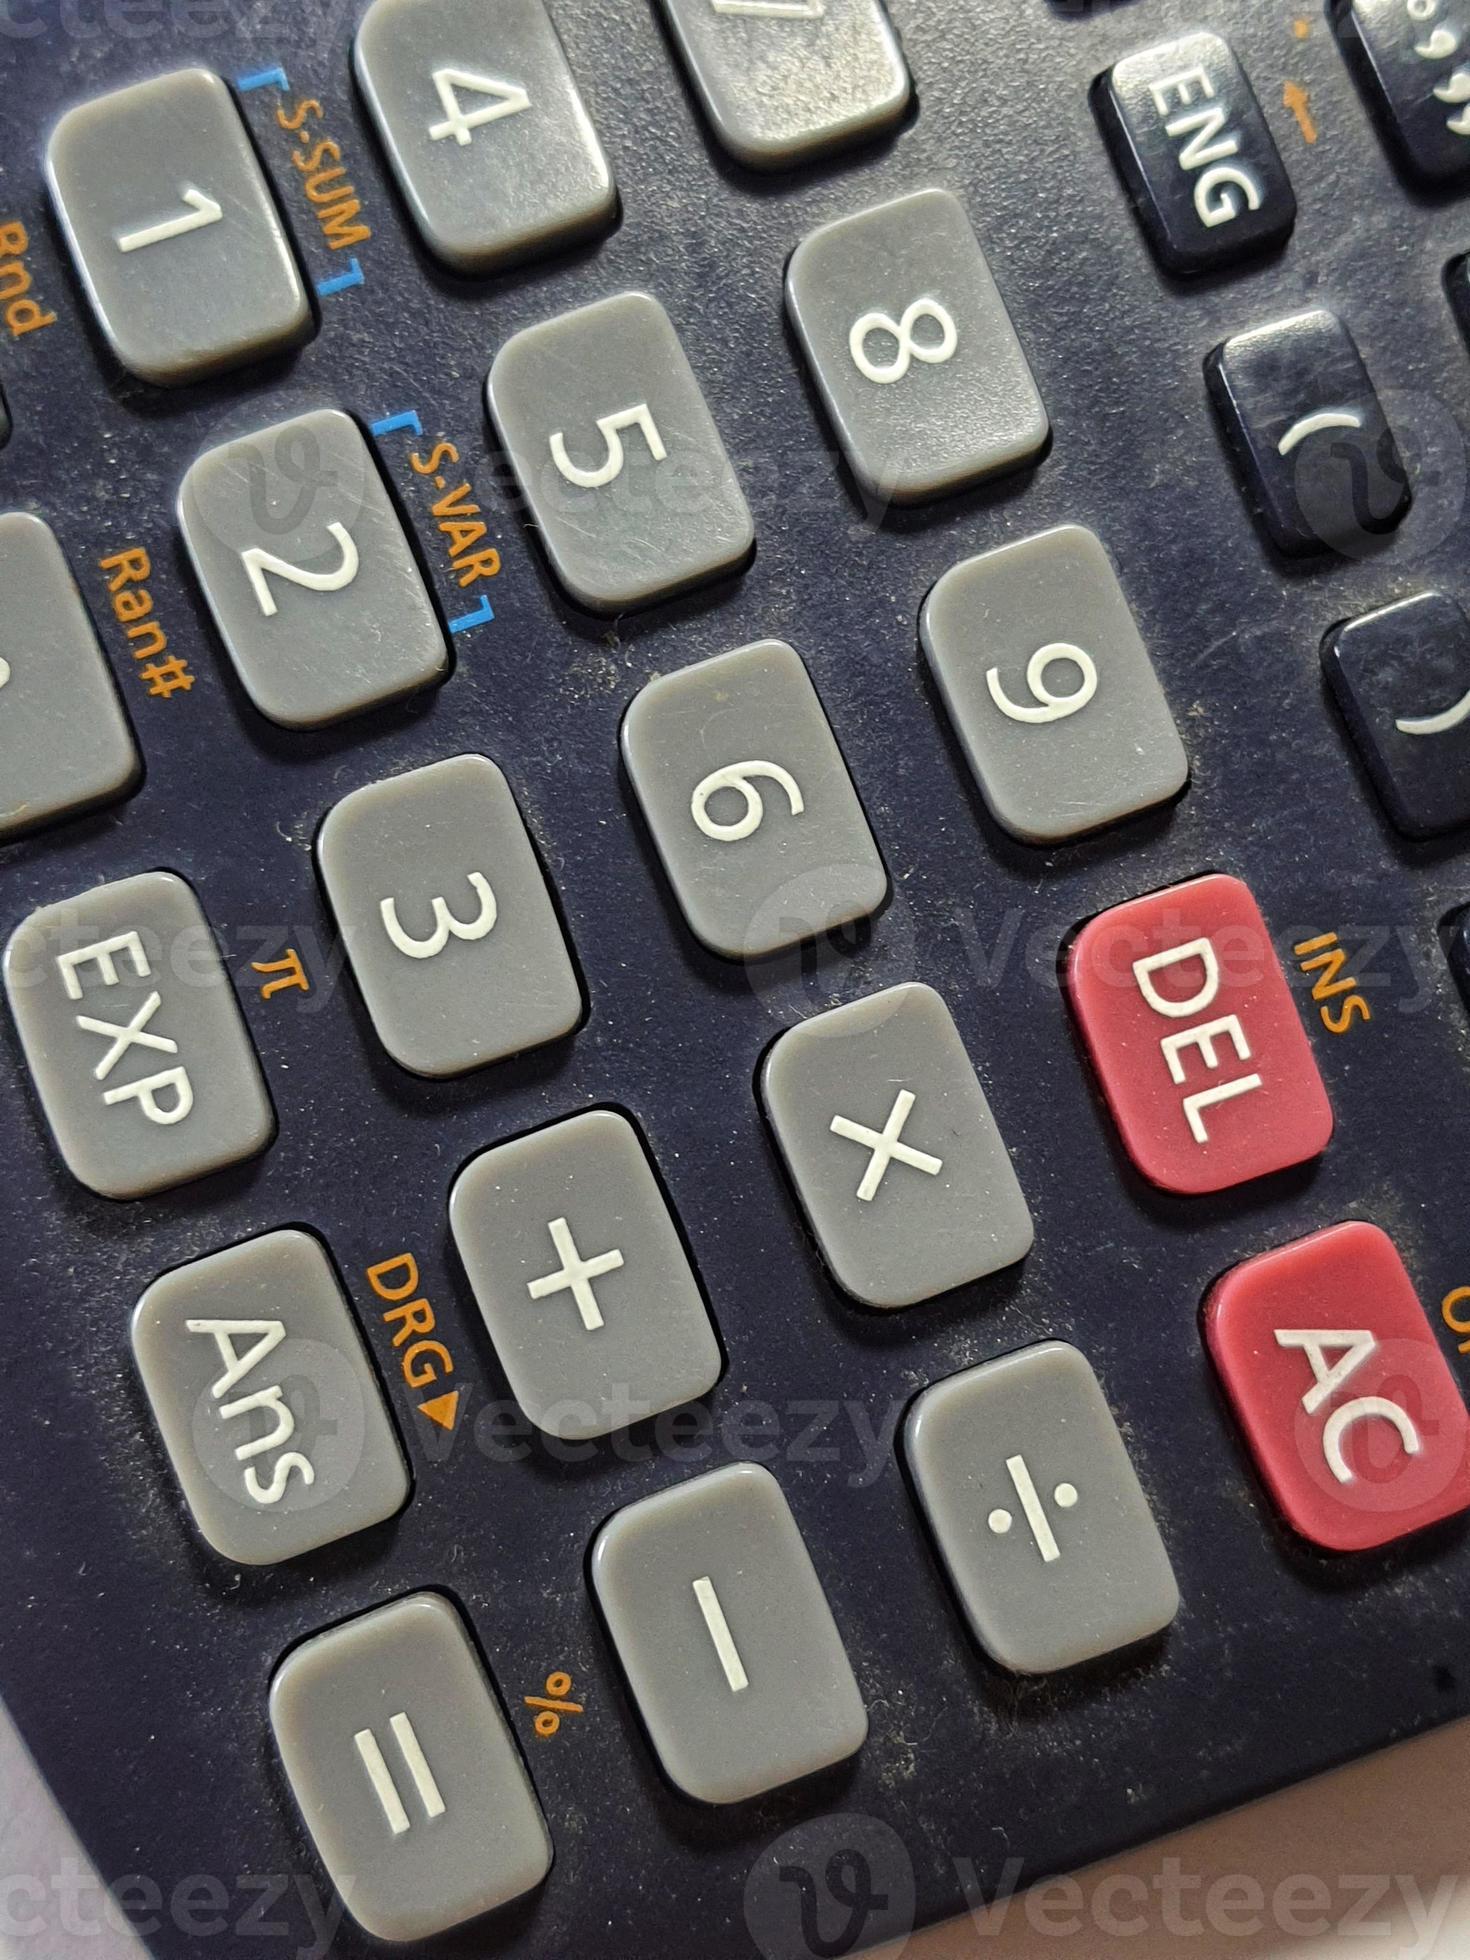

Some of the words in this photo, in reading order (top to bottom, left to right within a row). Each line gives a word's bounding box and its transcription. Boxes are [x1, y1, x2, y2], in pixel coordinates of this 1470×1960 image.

[428, 66, 533, 146] 4
[1149, 65, 1262, 228] ENG
[117, 188, 223, 252] 1
[0, 221, 57, 337] Rnd
[849, 296, 958, 384] 8
[549, 403, 667, 488] 5
[241, 521, 359, 616] 2
[99, 547, 195, 698] Ran#
[986, 642, 1098, 723] 9
[691, 760, 804, 841] 6
[380, 871, 497, 959] 3
[57, 931, 193, 1125] EXP
[1294, 932, 1371, 1034] INS
[1132, 937, 1263, 1143] DEL
[366, 1253, 454, 1388] DRG
[186, 1319, 315, 1504] Ans
[1274, 1329, 1421, 1483] AC
[525, 1671, 583, 1737] %
